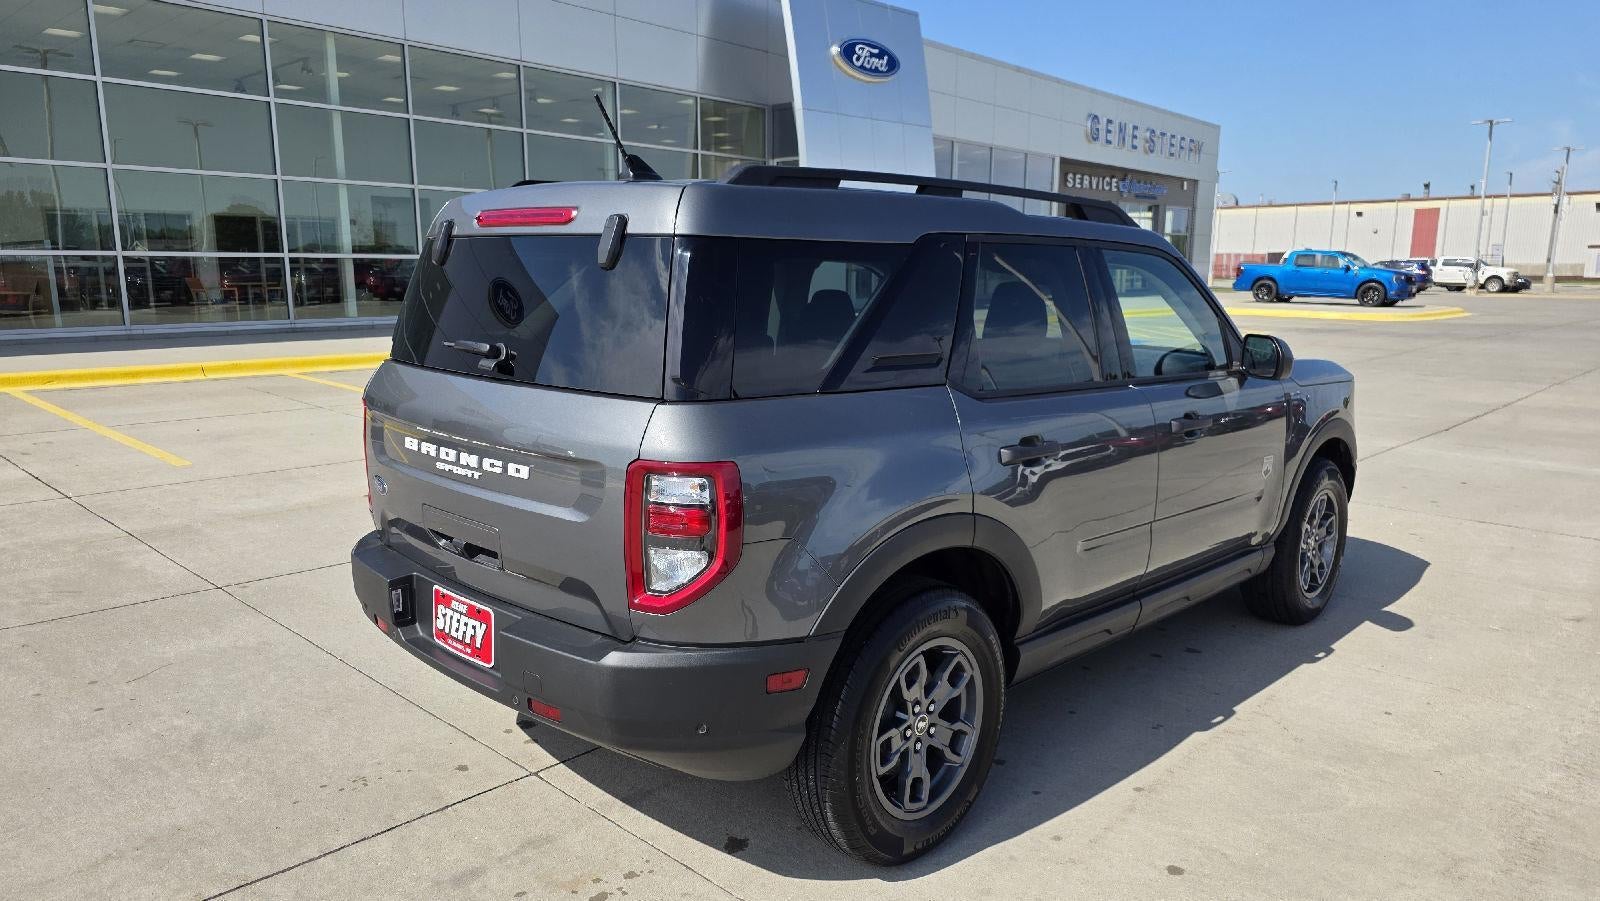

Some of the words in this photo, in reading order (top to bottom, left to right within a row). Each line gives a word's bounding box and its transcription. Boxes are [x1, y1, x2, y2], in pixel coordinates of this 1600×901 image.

[853, 44, 888, 72] Ford
[1086, 113, 1139, 150] GENE
[1145, 128, 1204, 161] STEFFY
[1066, 172, 1119, 192] SERVICE
[404, 436, 530, 480] BRONCO
[435, 461, 483, 480] SPORT
[436, 604, 487, 649] STEFFY
